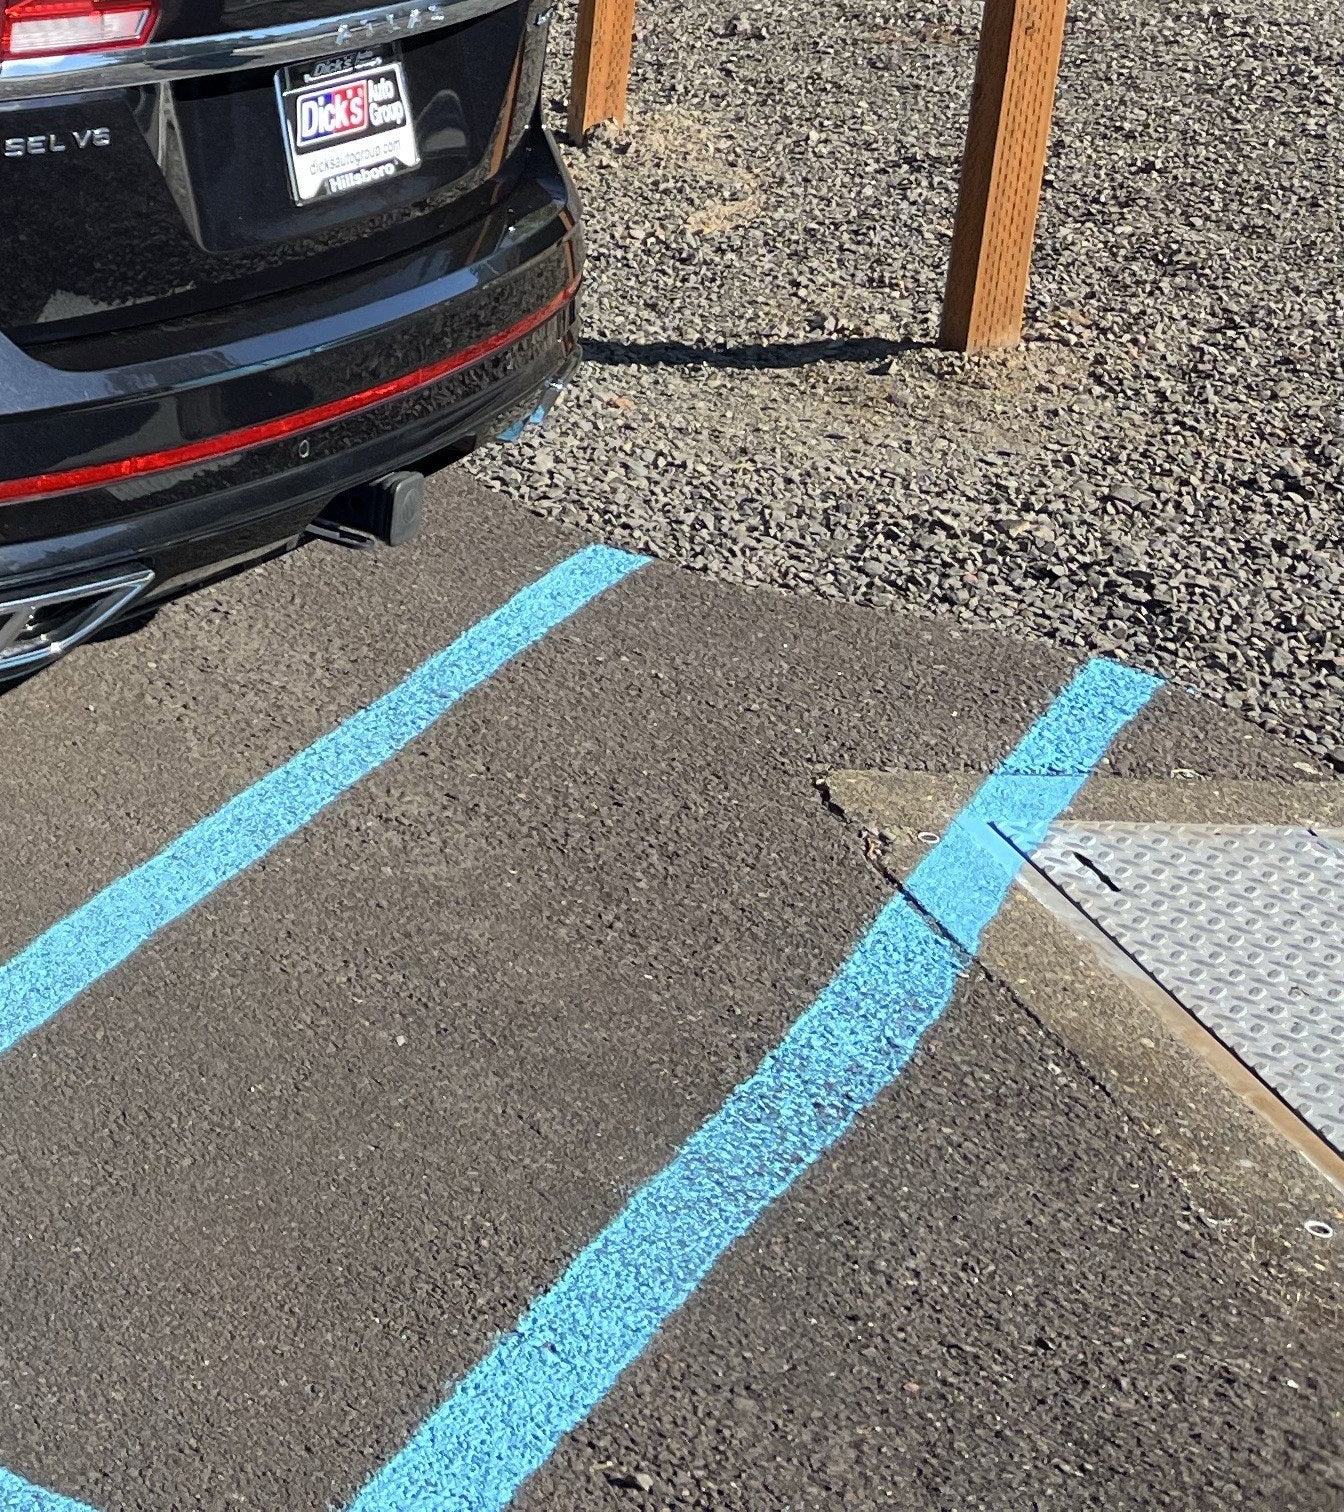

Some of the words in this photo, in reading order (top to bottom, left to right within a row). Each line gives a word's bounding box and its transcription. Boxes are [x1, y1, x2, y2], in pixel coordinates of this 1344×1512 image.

[301, 88, 364, 138] Dick's
[368, 77, 395, 103] Auto
[368, 100, 404, 126] Group
[4, 134, 66, 157] SEL
[72, 127, 110, 148] V6
[328, 162, 395, 193] Hillsboro
